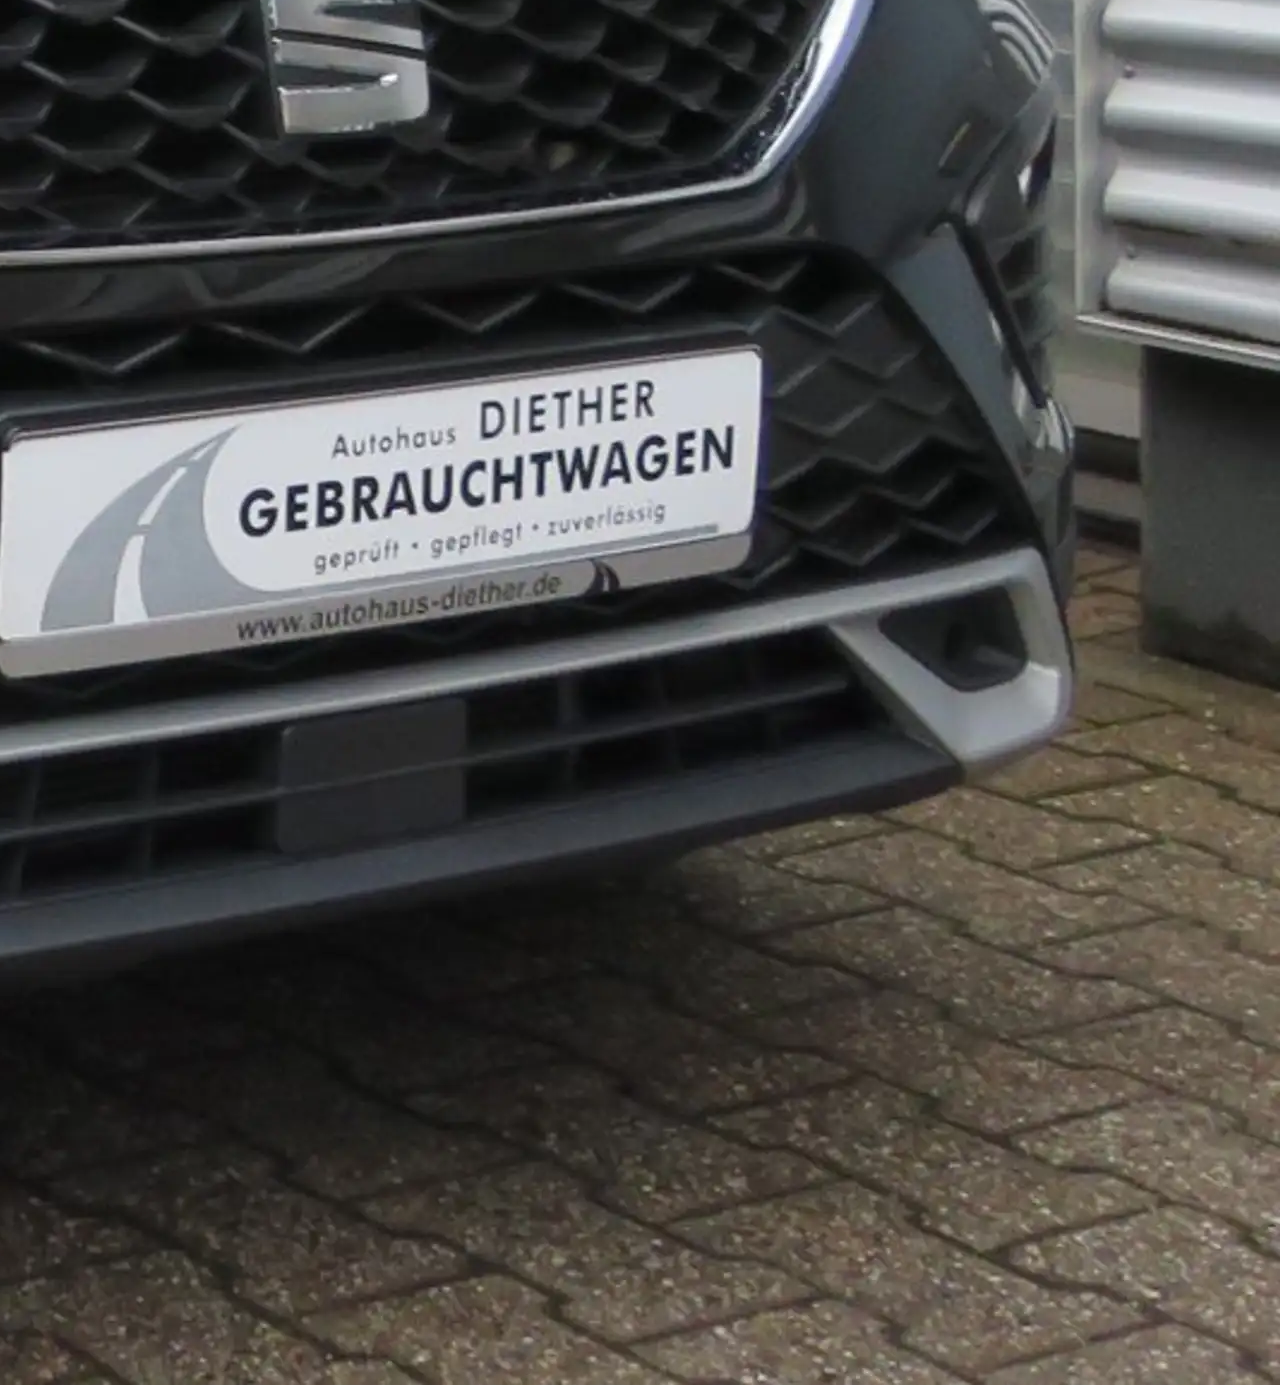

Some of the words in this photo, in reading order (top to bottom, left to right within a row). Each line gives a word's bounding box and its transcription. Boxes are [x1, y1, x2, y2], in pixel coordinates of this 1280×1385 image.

[331, 427, 457, 459] Autohaus
[480, 380, 656, 441] DIETHER
[239, 425, 735, 538] GEBRAUCHTWAGEN
[314, 540, 400, 575] geprüft
[430, 522, 523, 559] gepflegt
[547, 502, 666, 537] zuverlässig
[236, 572, 563, 642] www.autohaus-diether.de
